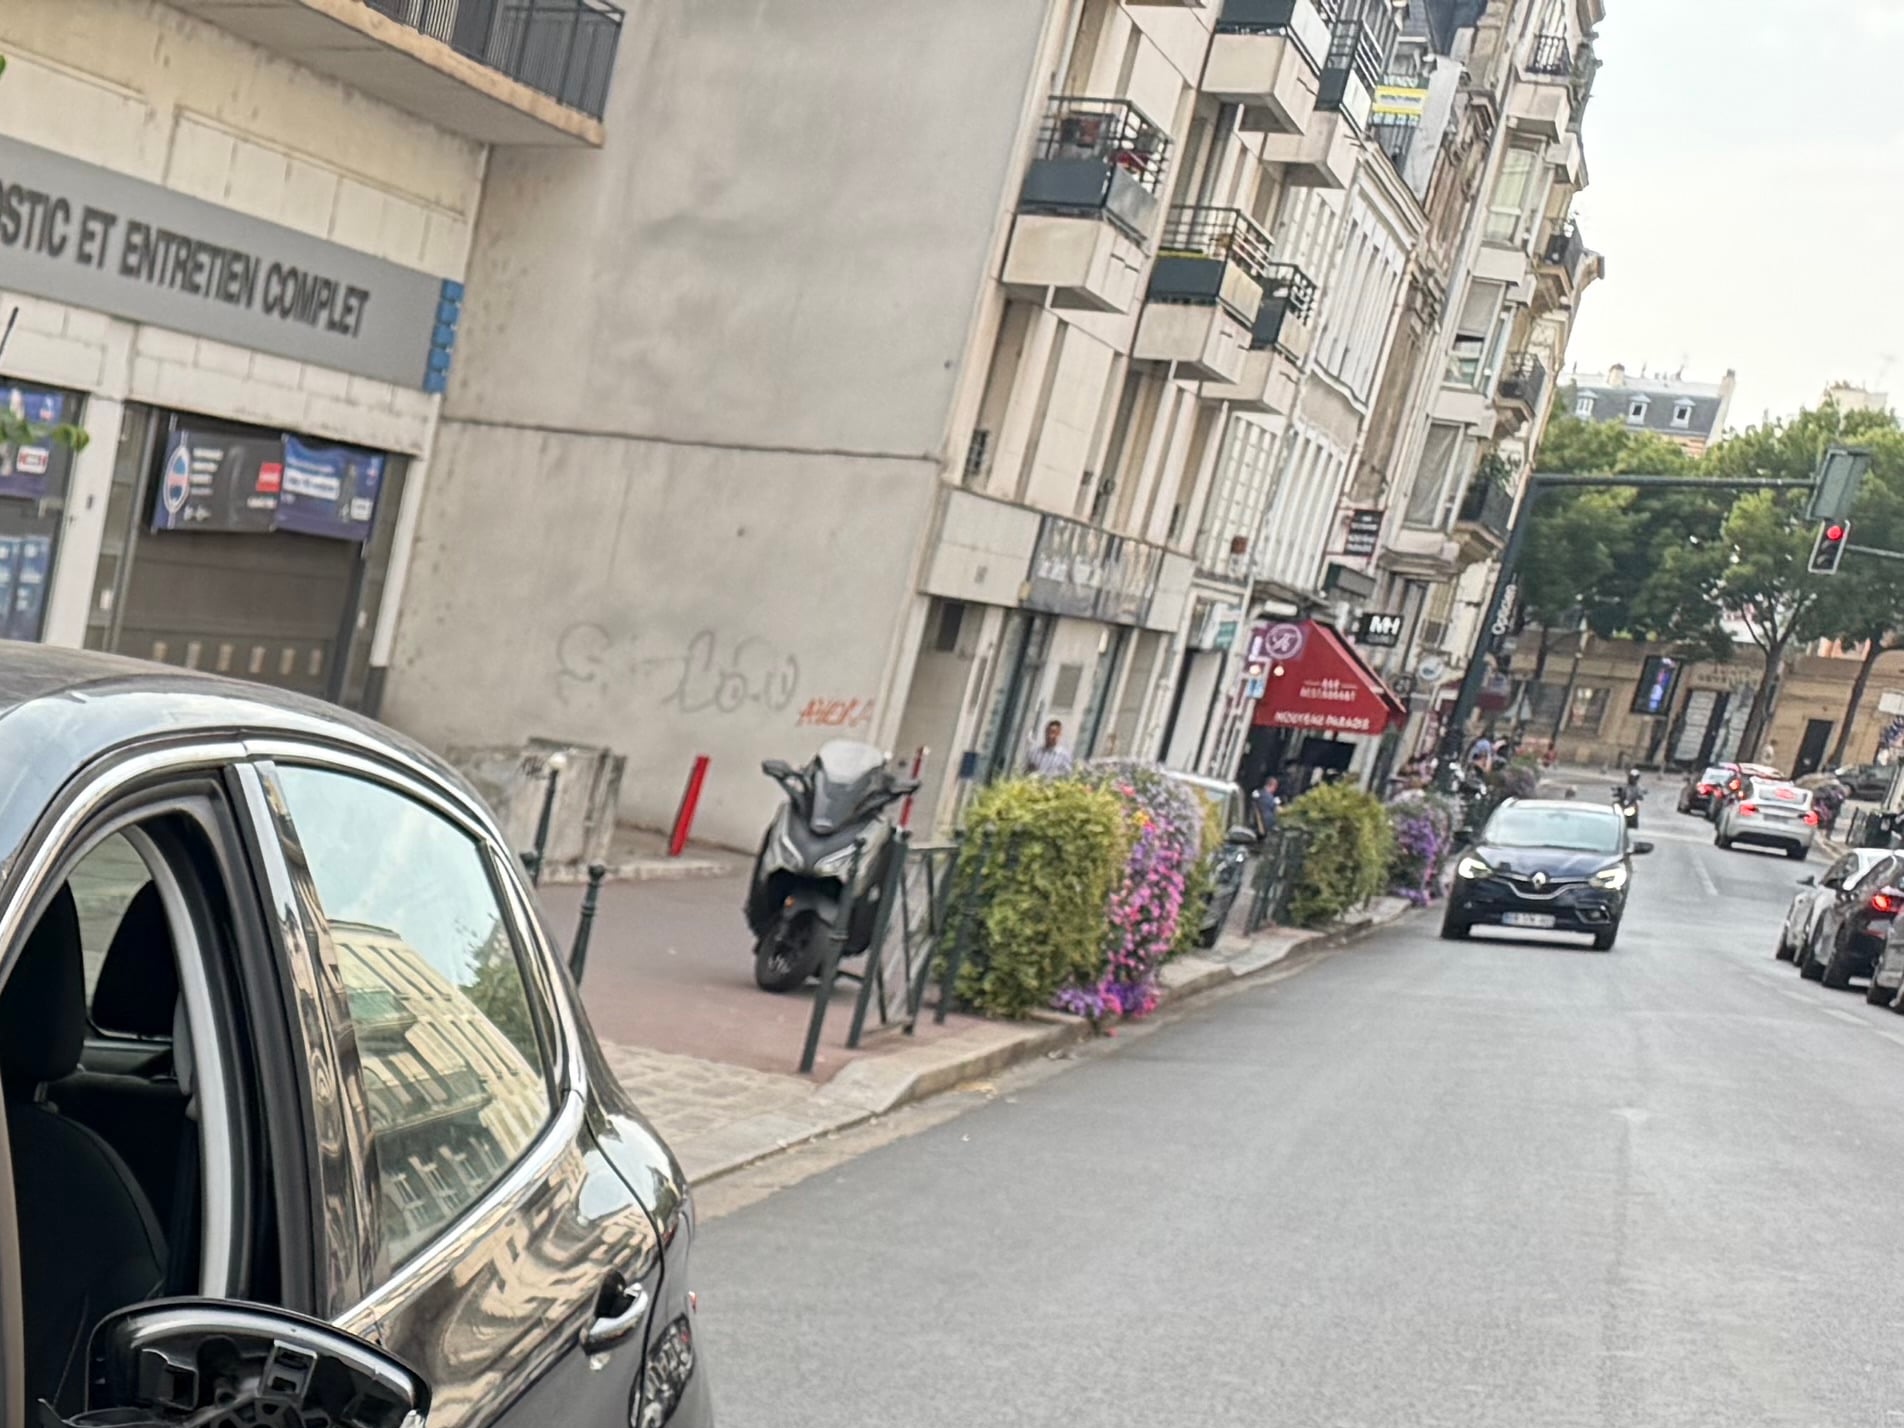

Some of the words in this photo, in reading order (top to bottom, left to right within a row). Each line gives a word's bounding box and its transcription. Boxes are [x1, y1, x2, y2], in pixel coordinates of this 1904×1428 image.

[76, 207, 117, 271] ET
[119, 220, 261, 310] ENTRETIEN
[261, 262, 371, 339] COMPLET
